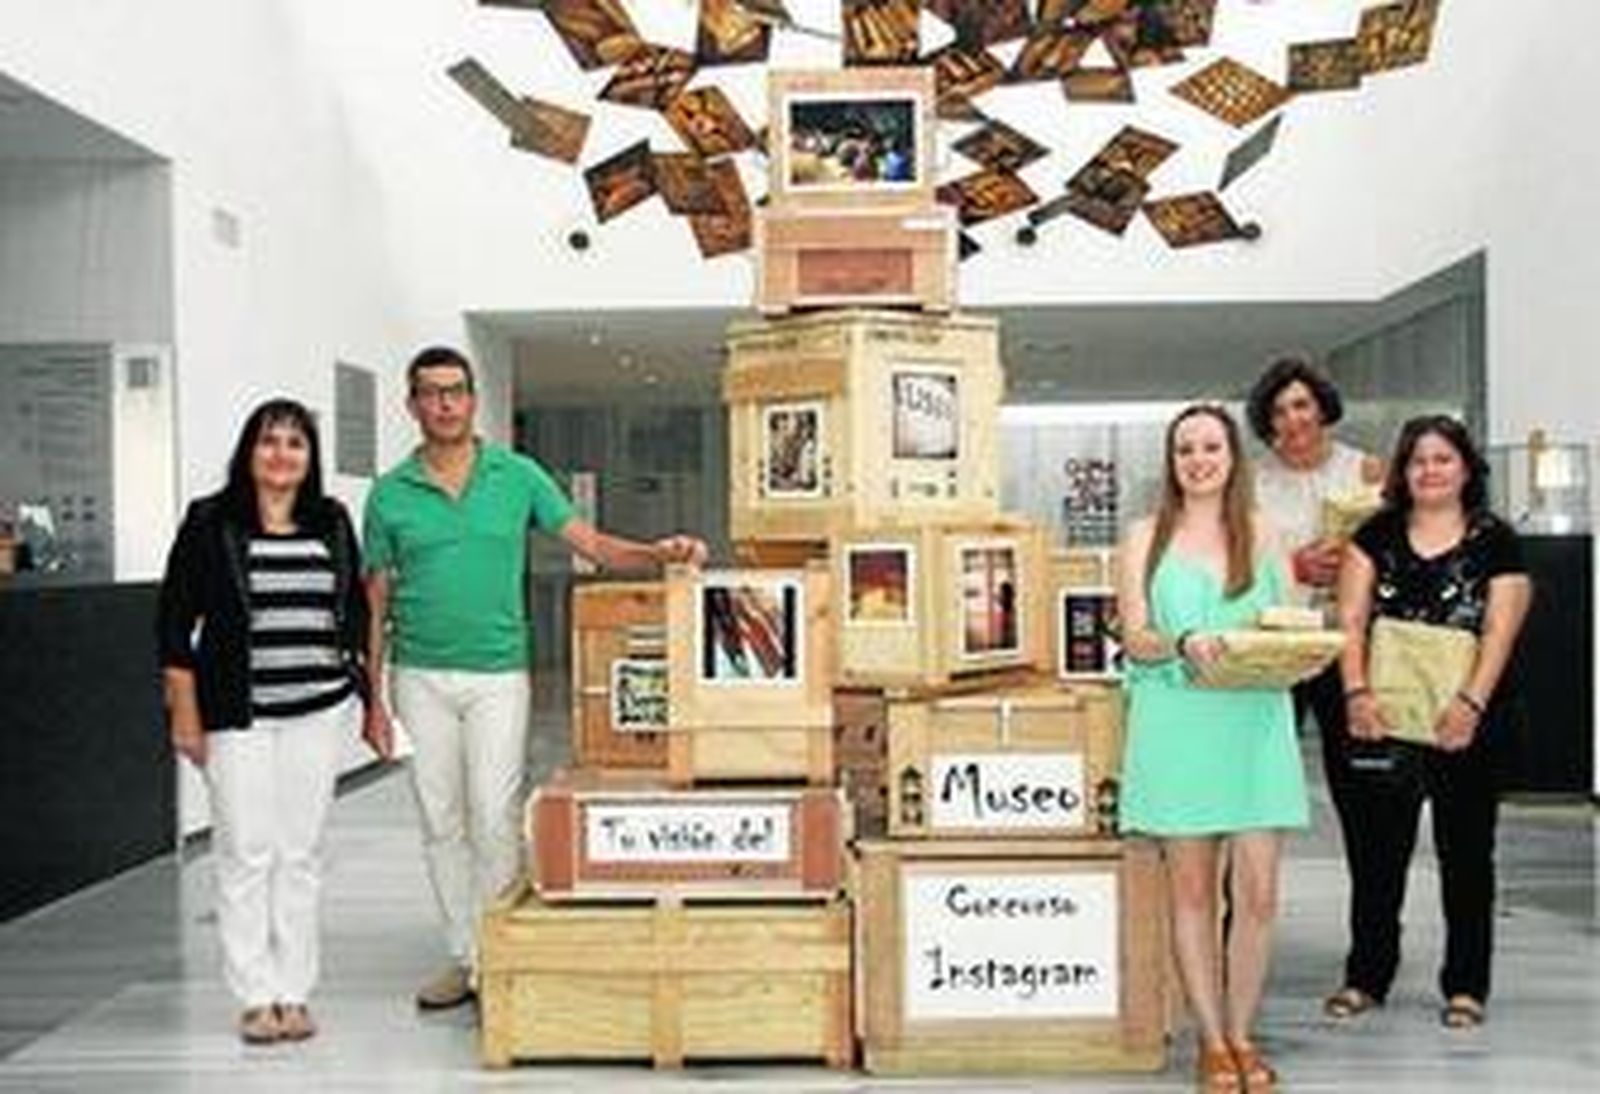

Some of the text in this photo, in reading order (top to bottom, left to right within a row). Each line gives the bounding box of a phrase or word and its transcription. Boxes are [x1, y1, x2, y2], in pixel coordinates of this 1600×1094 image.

[941, 763, 1080, 817] Museo
[601, 816, 636, 850] Tu
[732, 815, 773, 851] del
[924, 946, 1099, 1000] Instagram
